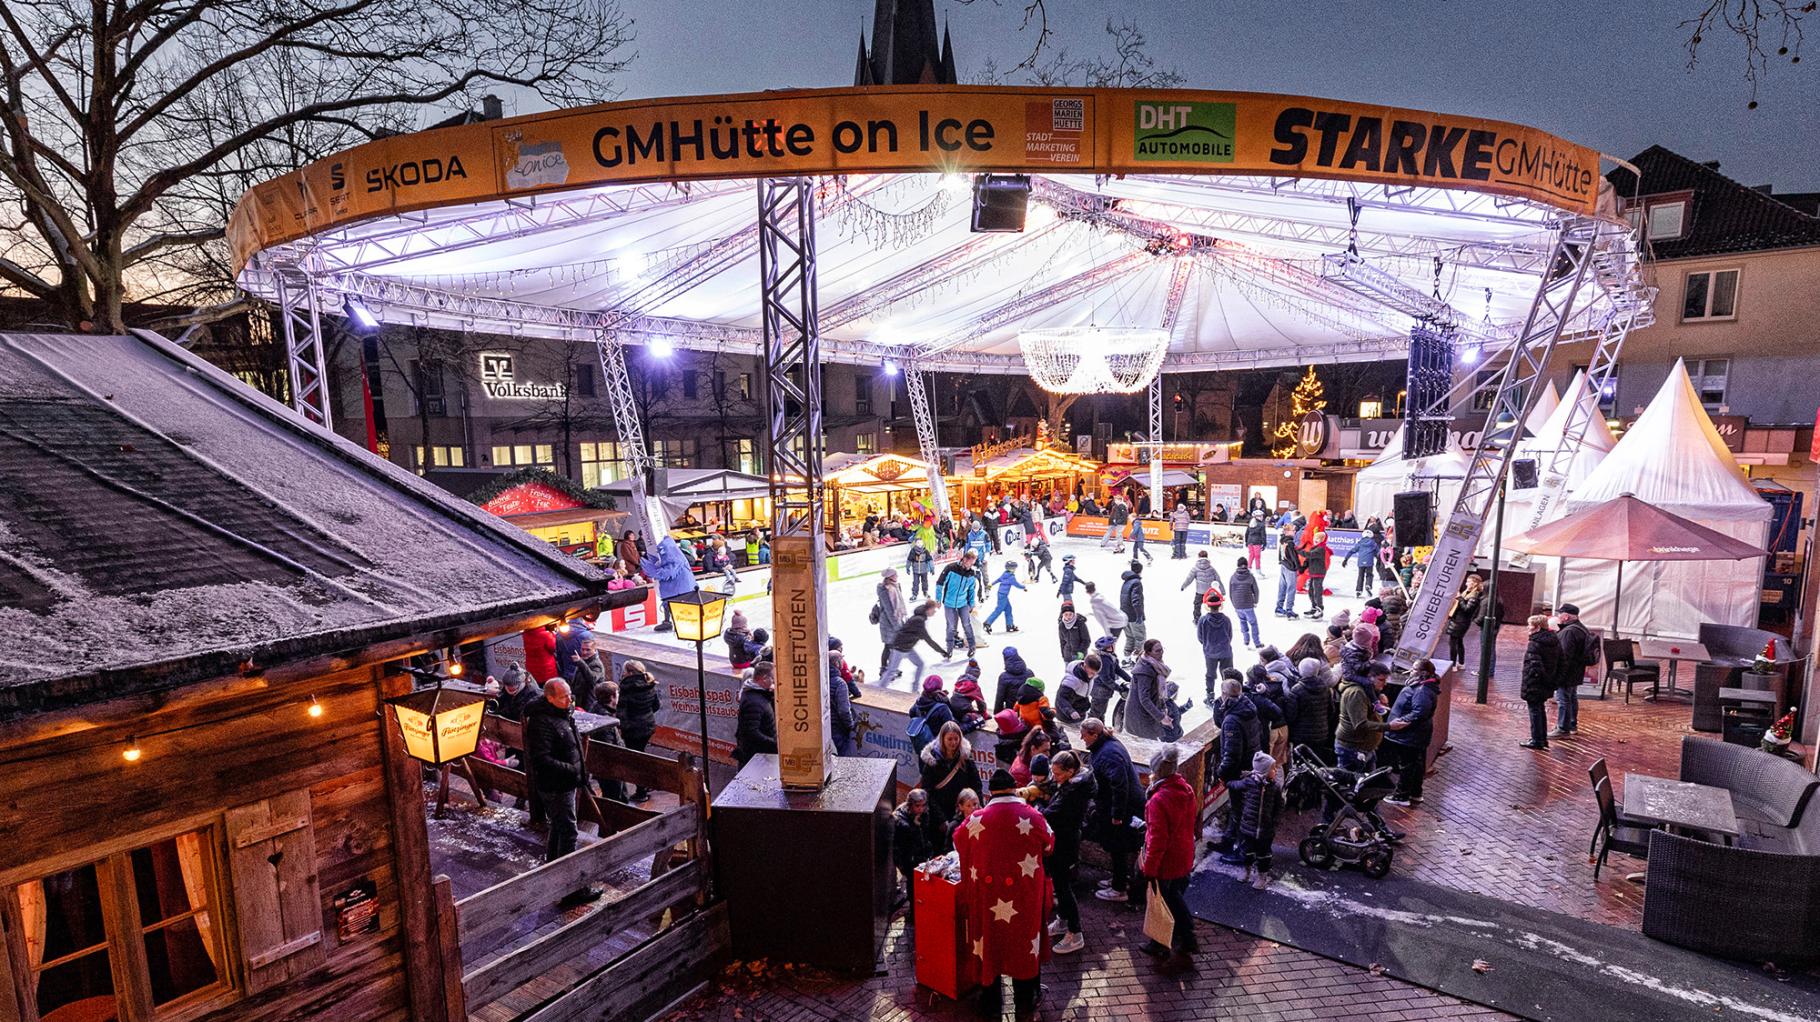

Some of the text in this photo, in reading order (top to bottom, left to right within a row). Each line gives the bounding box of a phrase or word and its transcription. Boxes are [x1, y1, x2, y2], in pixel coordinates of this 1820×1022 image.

[1053, 100, 1082, 109] GEORGS
[1053, 110, 1083, 118] MARIEN
[1139, 105, 1192, 130] DHT
[1053, 119, 1083, 129] HUETTE
[592, 110, 995, 168] GMHütte on Ice
[1026, 132, 1052, 142] STADT
[1026, 142, 1076, 153] MARKETING
[1138, 142, 1231, 156] AUTOMOBILE
[1050, 153, 1080, 163] VEREIN
[483, 381, 568, 399] Volksbank
[1415, 549, 1461, 640] SCHIEBETÜREN
[789, 589, 808, 732] SCHIEBETÜREN
